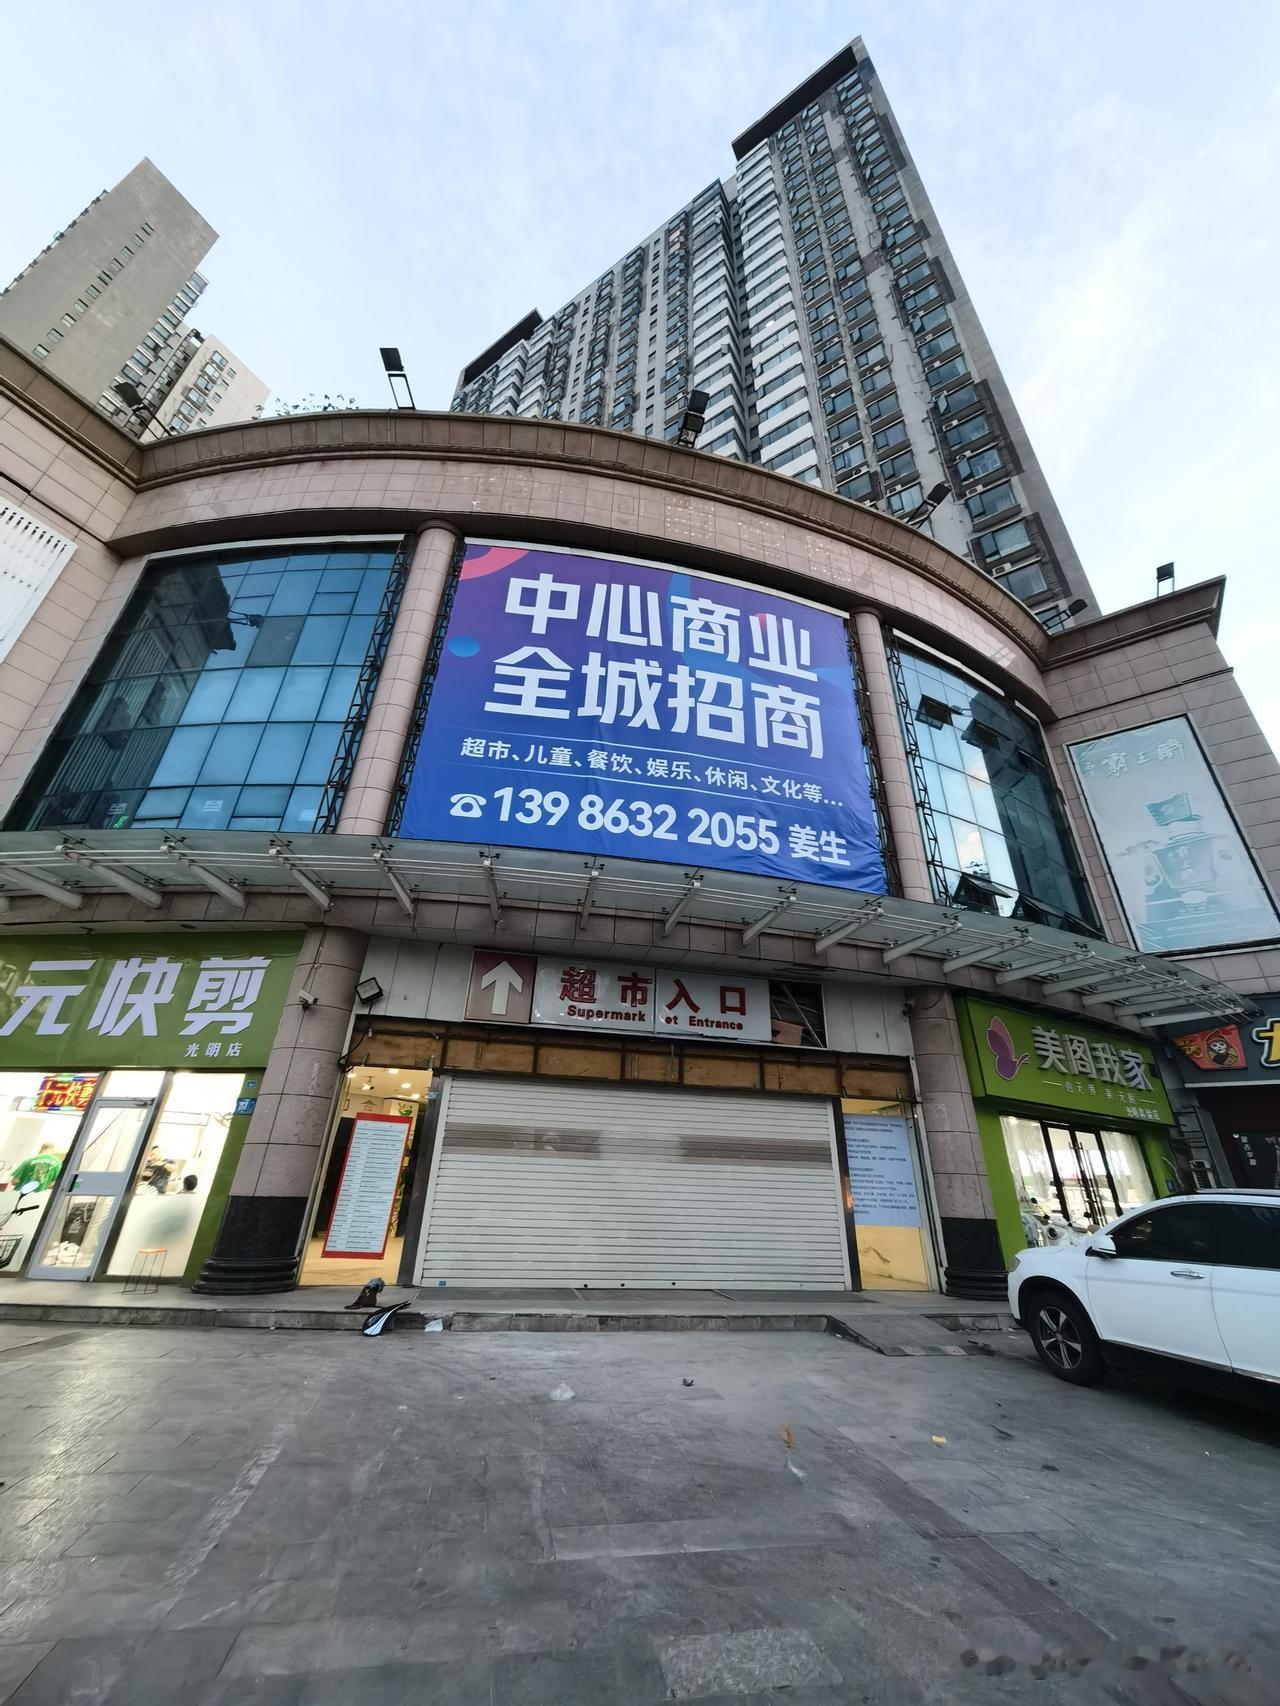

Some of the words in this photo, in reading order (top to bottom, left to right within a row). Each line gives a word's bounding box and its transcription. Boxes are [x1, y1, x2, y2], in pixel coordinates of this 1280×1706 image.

[505, 573, 818, 682] 中心商业
[484, 646, 824, 759] 全城招商
[494, 786, 570, 826] 139
[577, 794, 678, 841] 8632
[687, 808, 780, 855] 2055
[788, 824, 851, 866] 姜生
[0, 956, 272, 1036] 元快剪
[688, 1016, 743, 1031] Entrance
[184, 1042, 243, 1058] 光明店
[1031, 1025, 1154, 1091] 美阁我家
